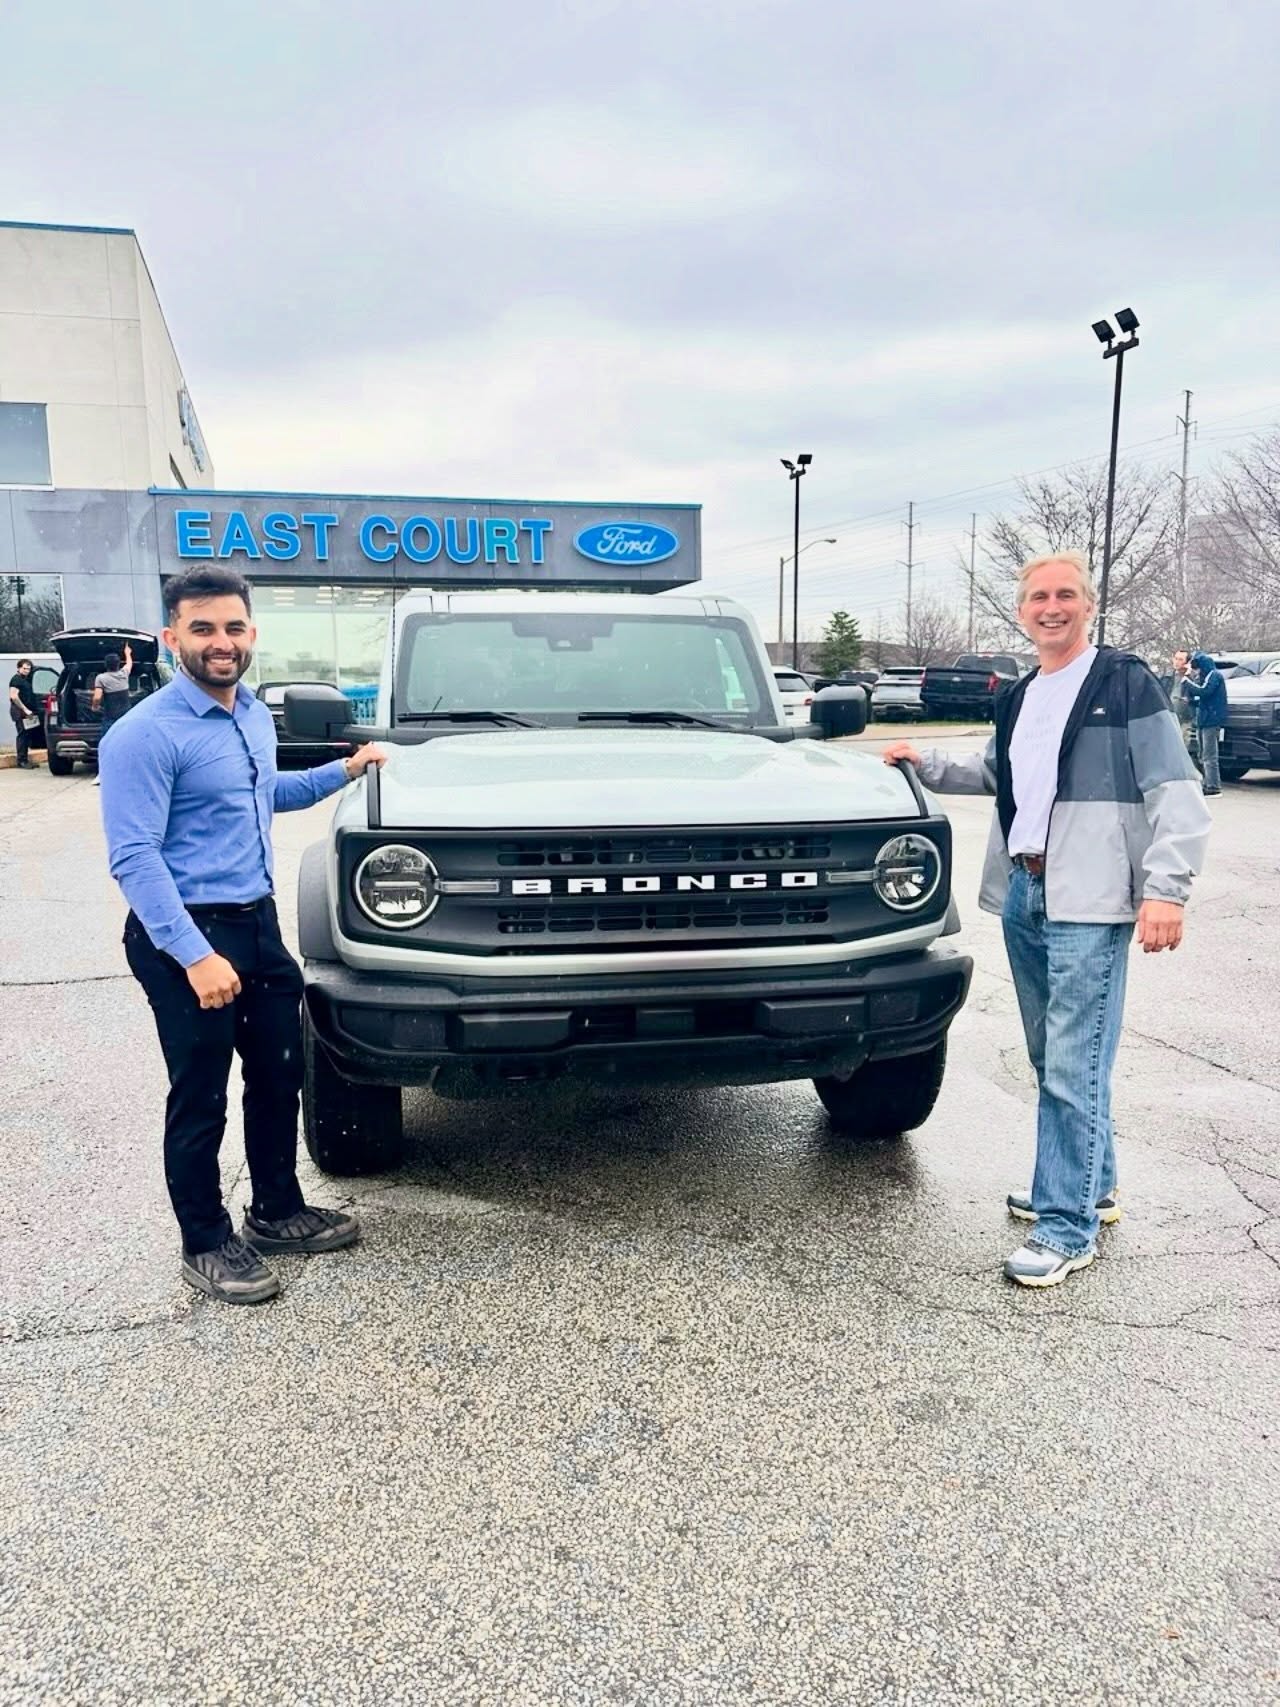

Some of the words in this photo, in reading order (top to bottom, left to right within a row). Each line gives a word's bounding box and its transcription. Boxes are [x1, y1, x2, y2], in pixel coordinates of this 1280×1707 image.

[175, 509, 339, 560] EAST
[360, 514, 553, 564] COURT
[596, 526, 656, 556] Ford
[512, 872, 818, 894] BRONCO
